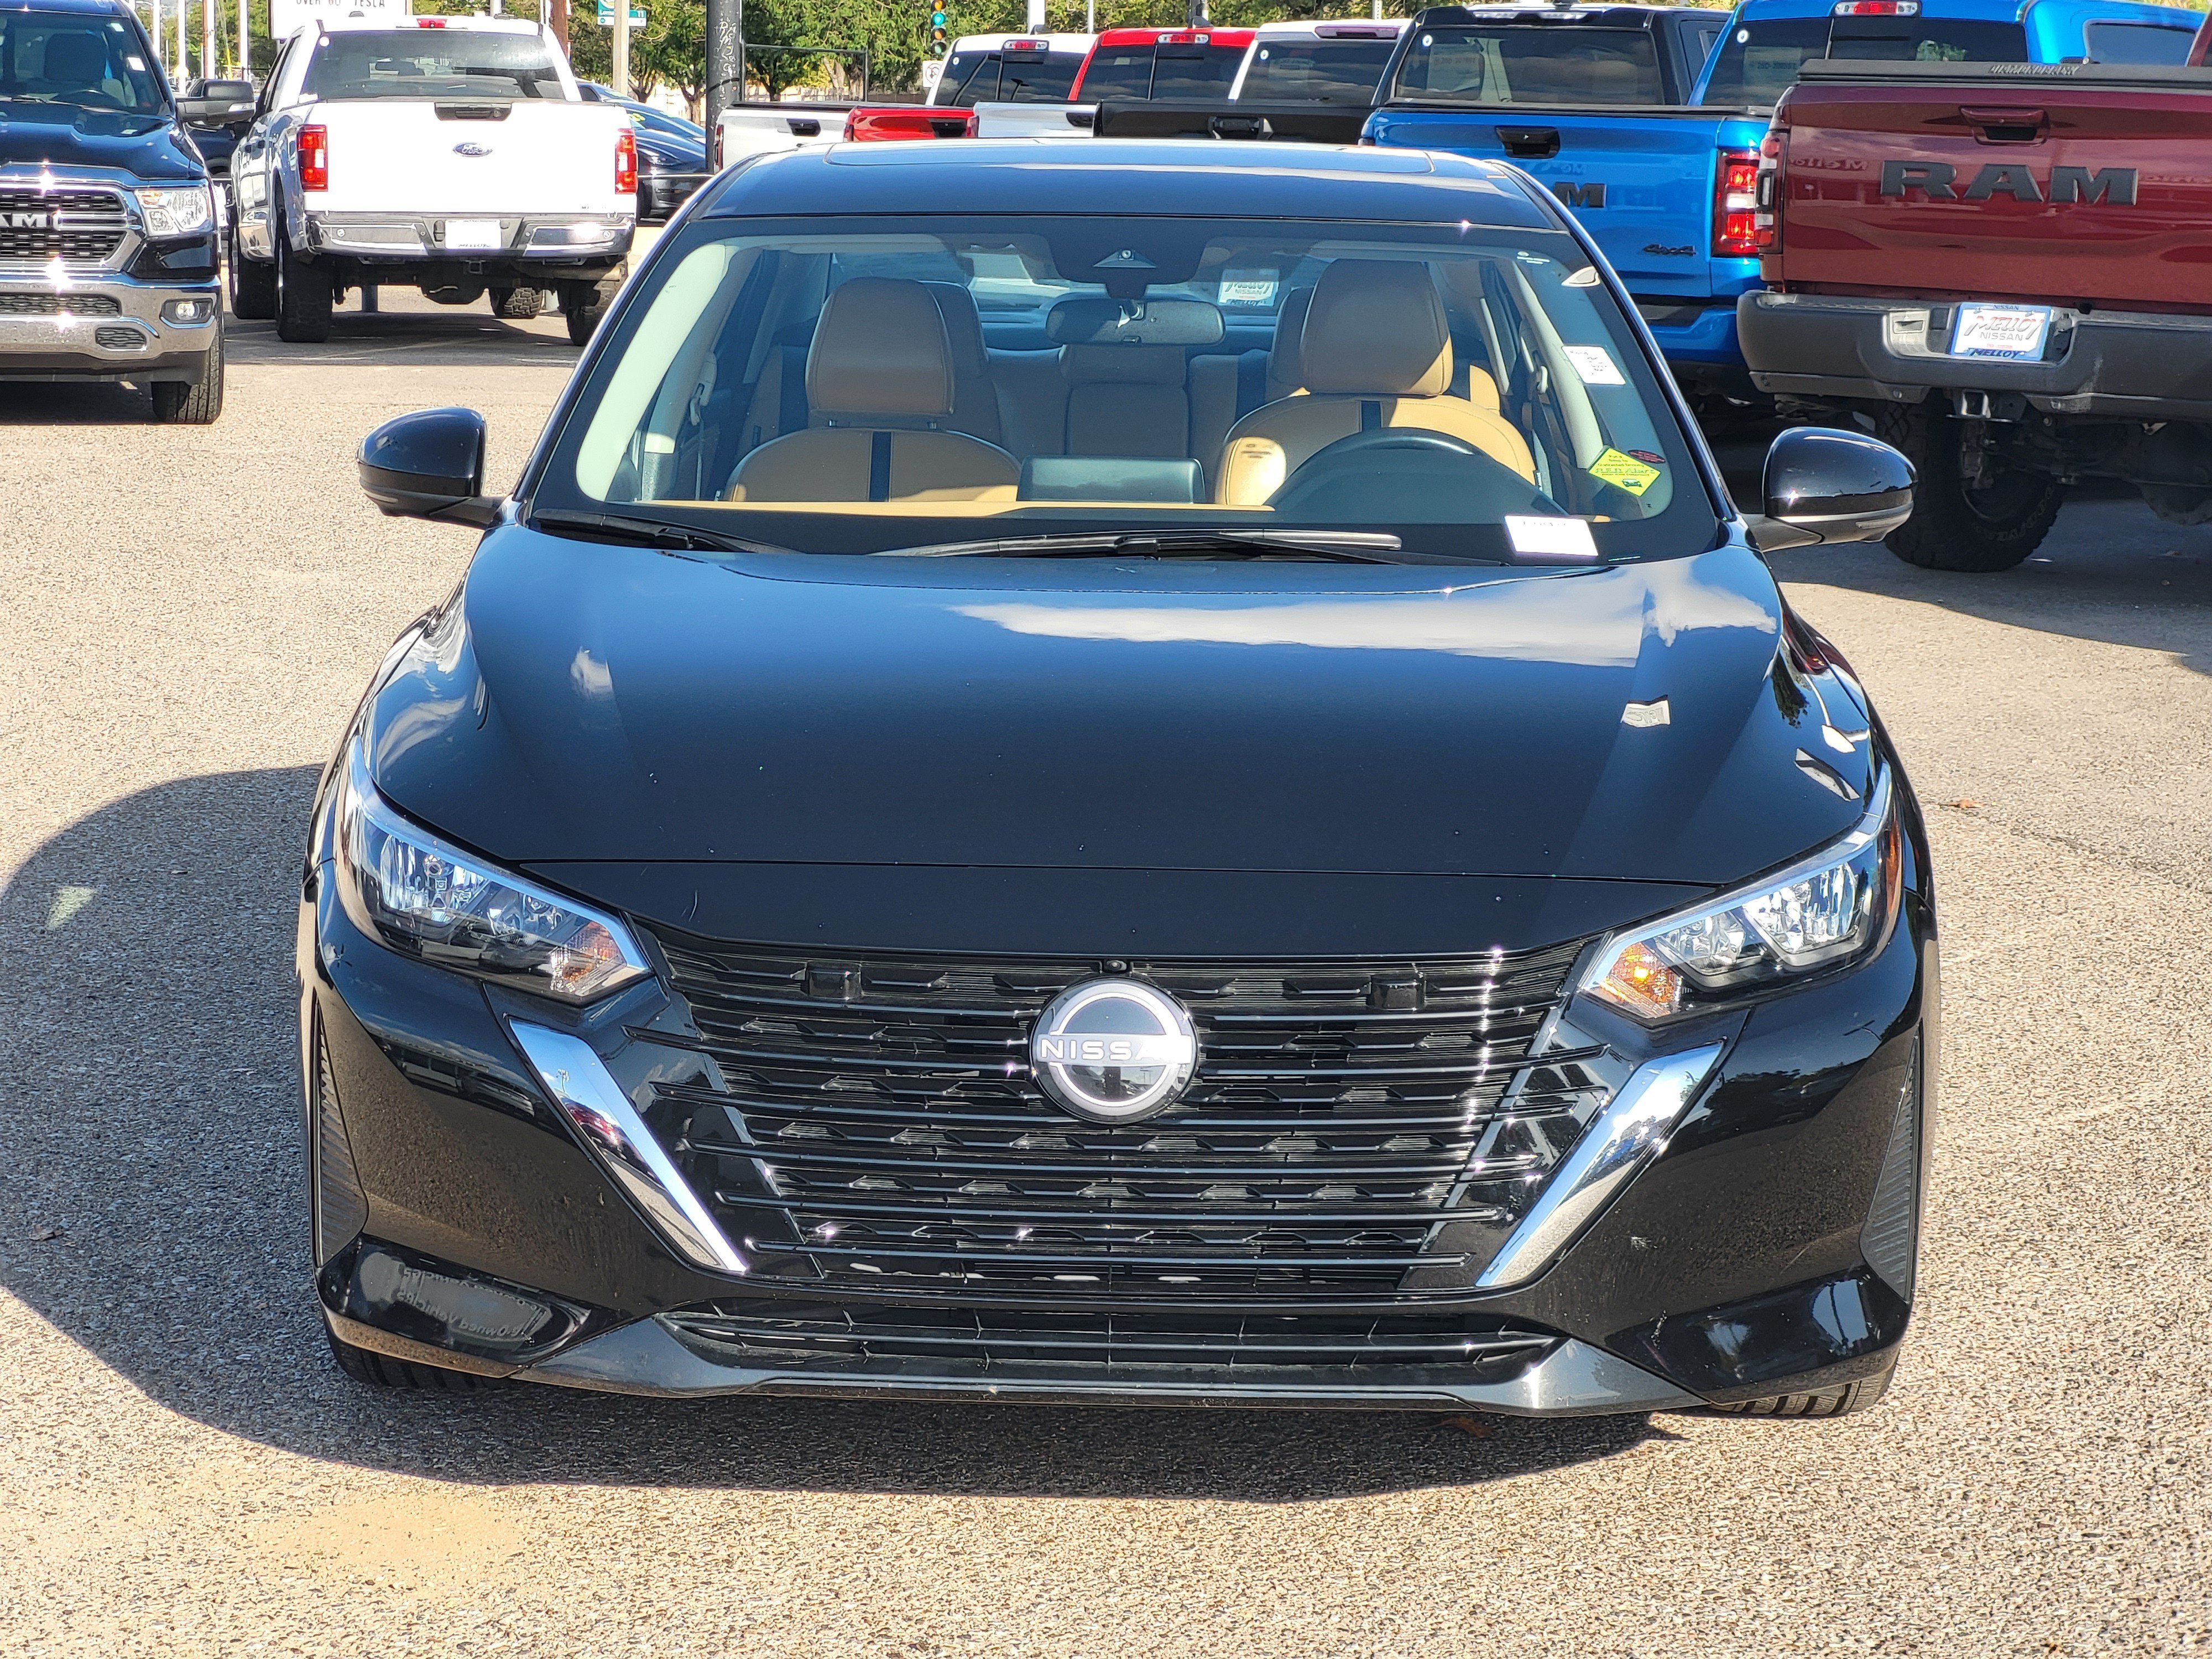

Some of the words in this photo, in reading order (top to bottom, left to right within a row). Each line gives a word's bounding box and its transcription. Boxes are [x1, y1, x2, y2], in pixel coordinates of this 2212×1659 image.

[1880, 160, 2138, 205] RAM
[1980, 332, 2024, 341] NISSAN
[1969, 348, 2019, 359] MELLOY
[1041, 1039, 1186, 1061] NISSA
